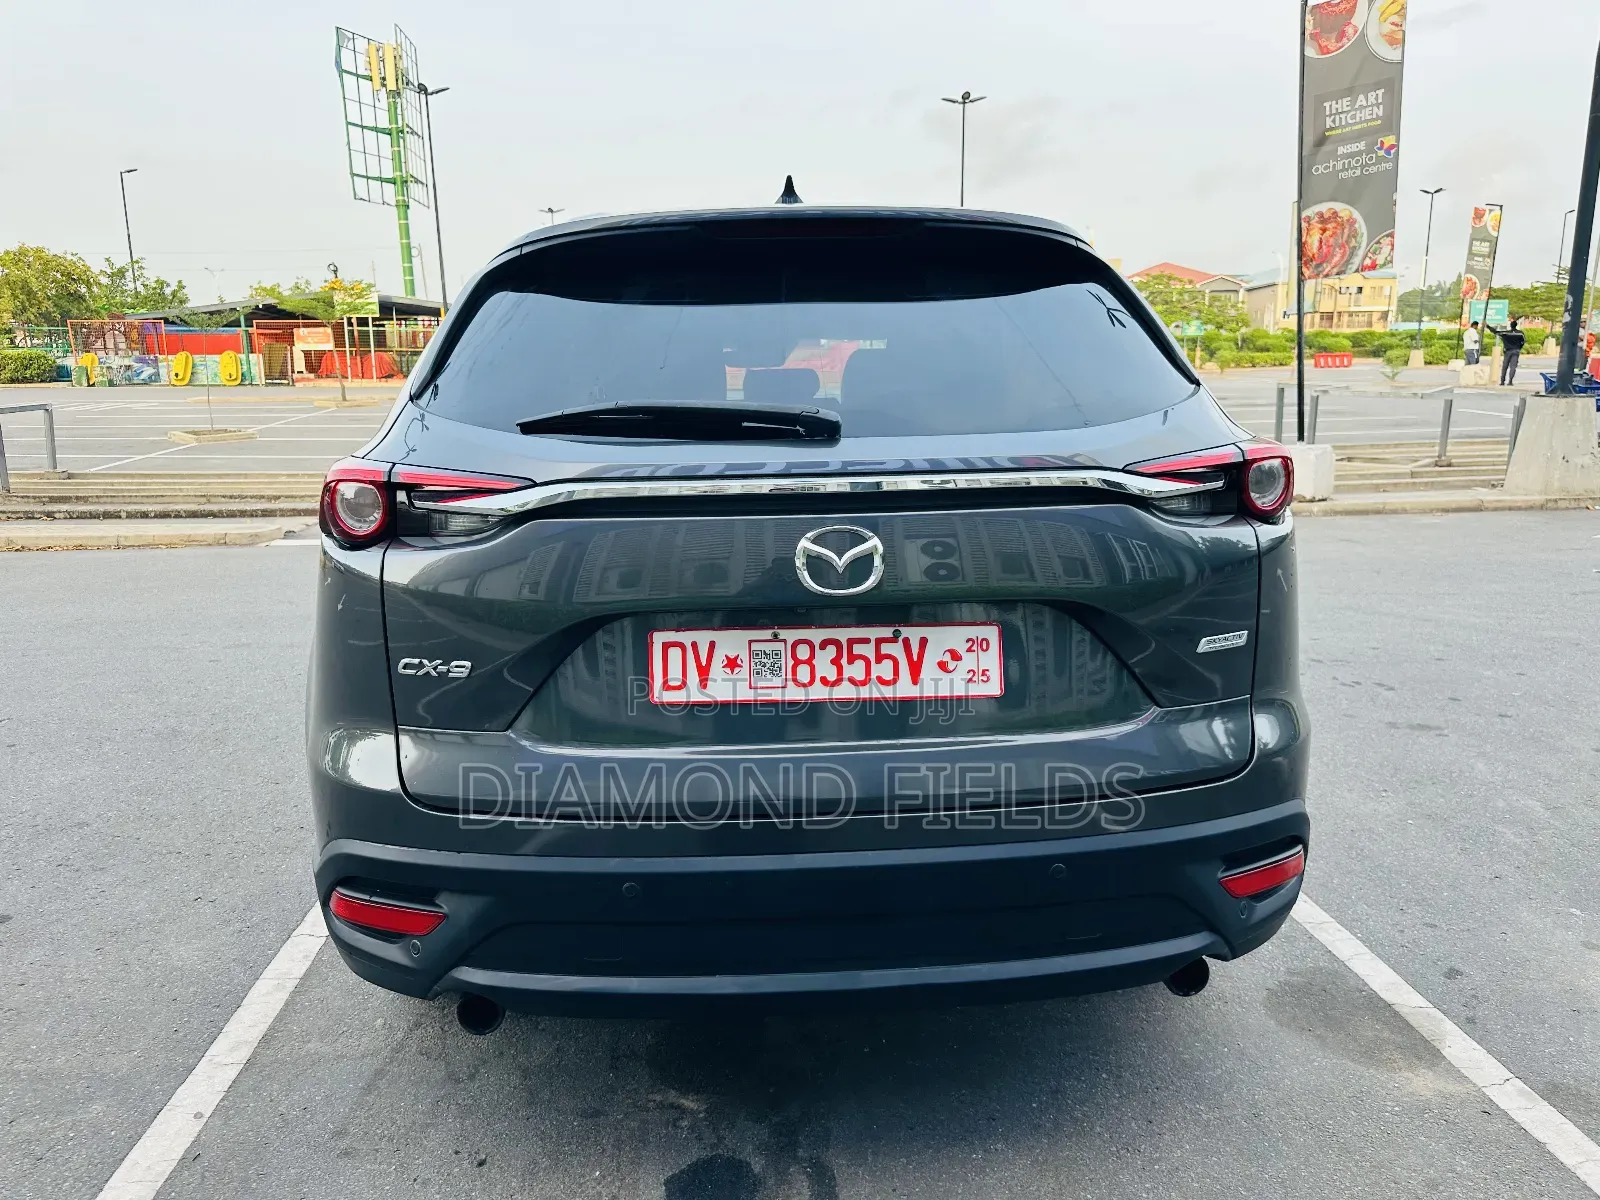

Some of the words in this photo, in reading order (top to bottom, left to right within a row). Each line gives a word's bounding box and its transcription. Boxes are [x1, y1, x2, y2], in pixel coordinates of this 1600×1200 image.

[1323, 96, 1351, 115] THE
[1354, 88, 1385, 108] ART
[1325, 105, 1384, 129] KITCHEN
[1337, 140, 1366, 155] INSIDE
[1311, 152, 1376, 175] achimota
[1338, 167, 1361, 180] retail
[1363, 162, 1393, 175] centre
[397, 657, 472, 678] CX-9
[661, 640, 716, 692] DV
[790, 636, 929, 688] 8355V
